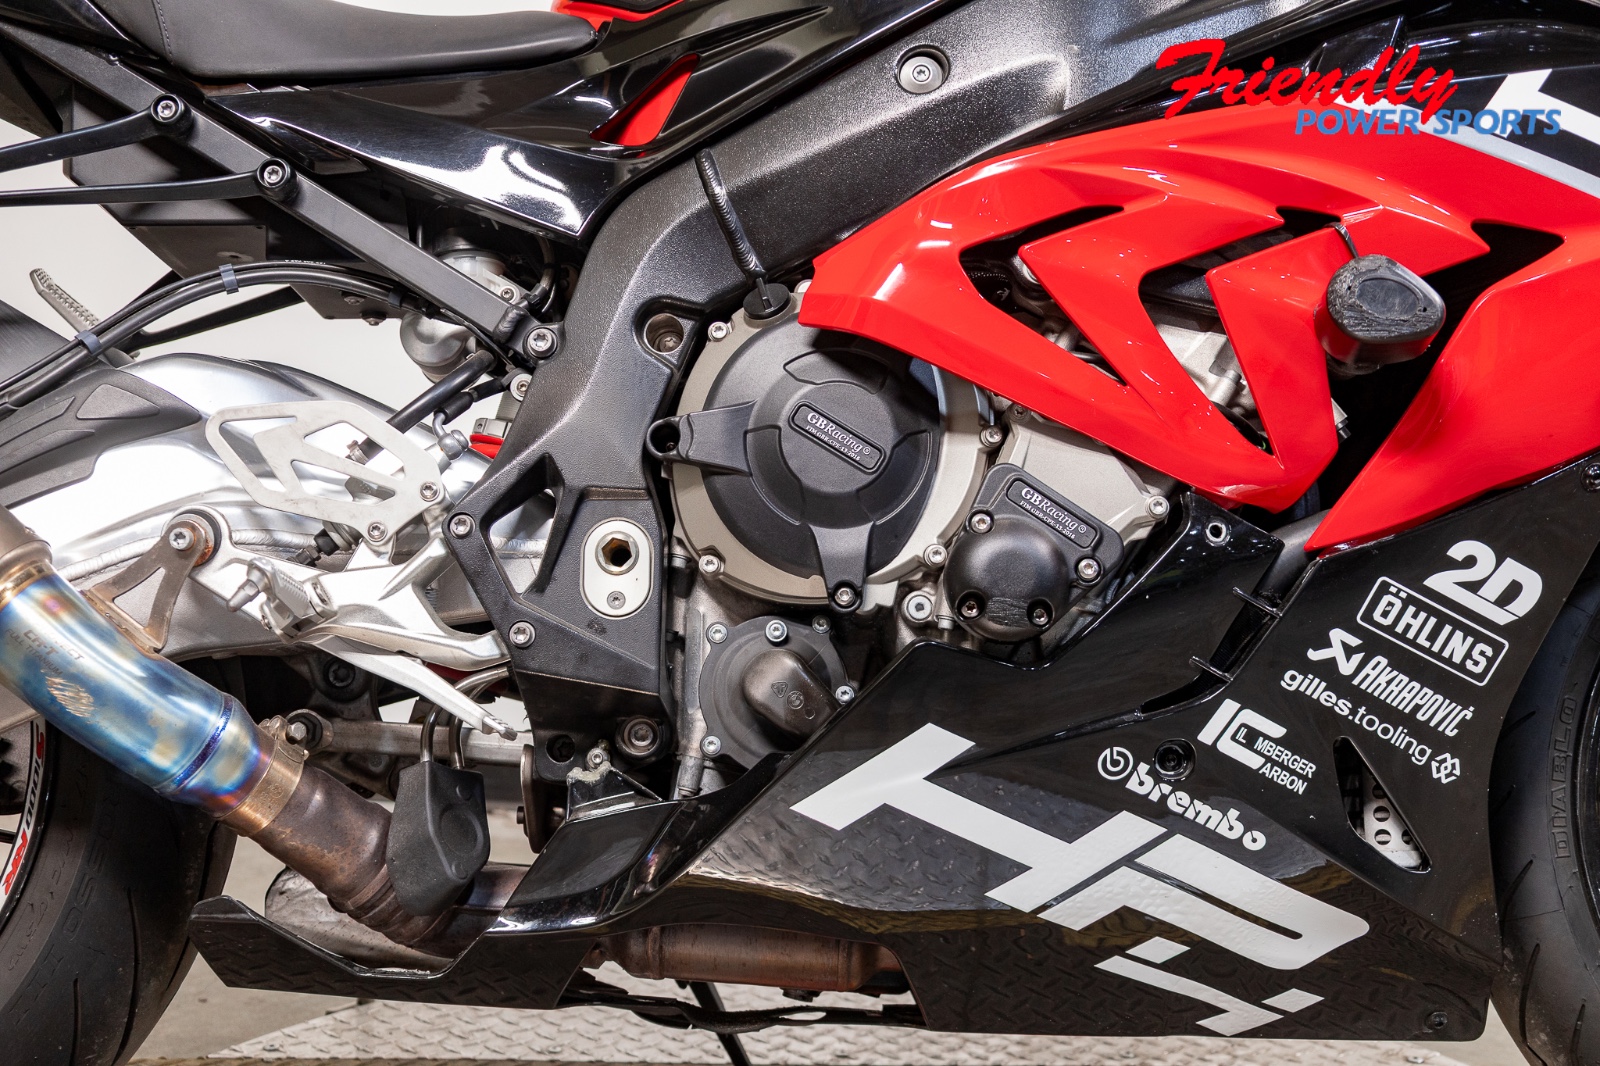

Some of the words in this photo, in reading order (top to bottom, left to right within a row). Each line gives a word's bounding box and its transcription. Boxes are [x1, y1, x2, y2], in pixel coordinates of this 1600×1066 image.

[1423, 539, 1543, 626] 2D
[1372, 584, 1494, 675] ÖHLINS
[1280, 669, 1433, 767] gilles.tooling
[1354, 654, 1475, 737] AKRAPOVIĆ
[1125, 762, 1267, 851] brembo
[1551, 697, 1578, 860] DIABLO
